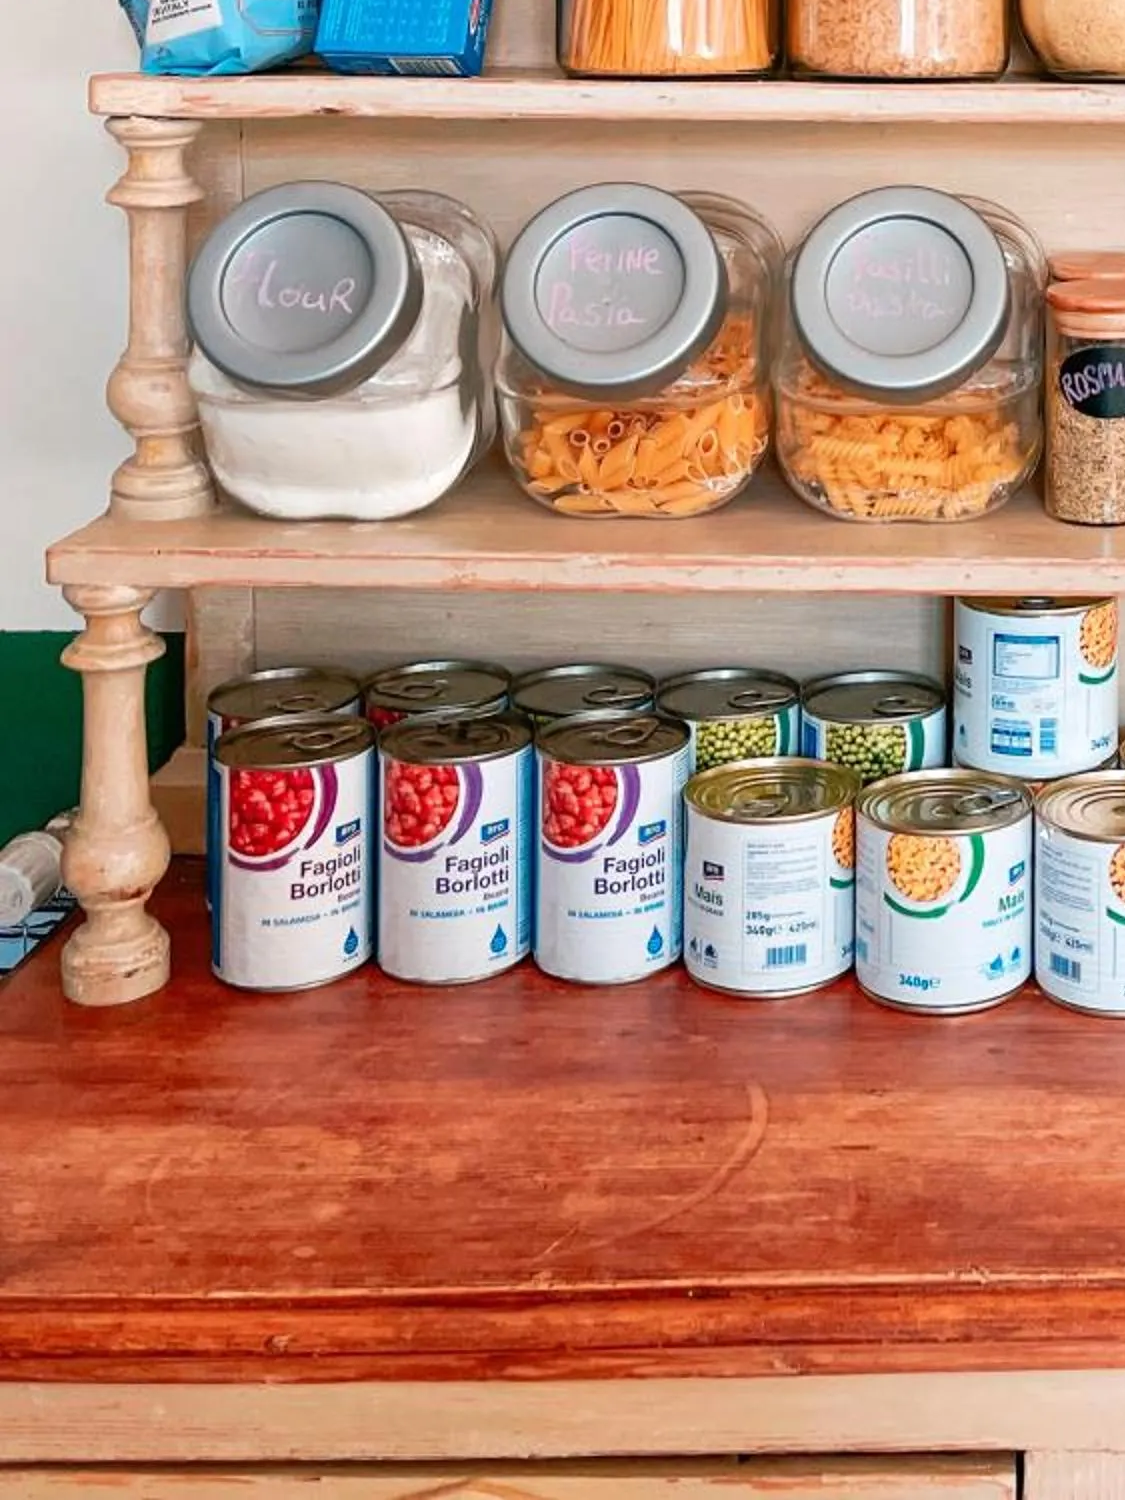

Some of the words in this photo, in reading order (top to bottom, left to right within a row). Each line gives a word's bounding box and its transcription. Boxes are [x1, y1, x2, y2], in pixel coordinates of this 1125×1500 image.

[300, 845, 361, 879] Fagioli
[445, 845, 510, 875] Fagioli
[603, 846, 666, 875] Fagioli
[290, 866, 361, 901] Borlotti
[436, 865, 510, 895] Borlotti
[594, 867, 666, 896] Borlotti
